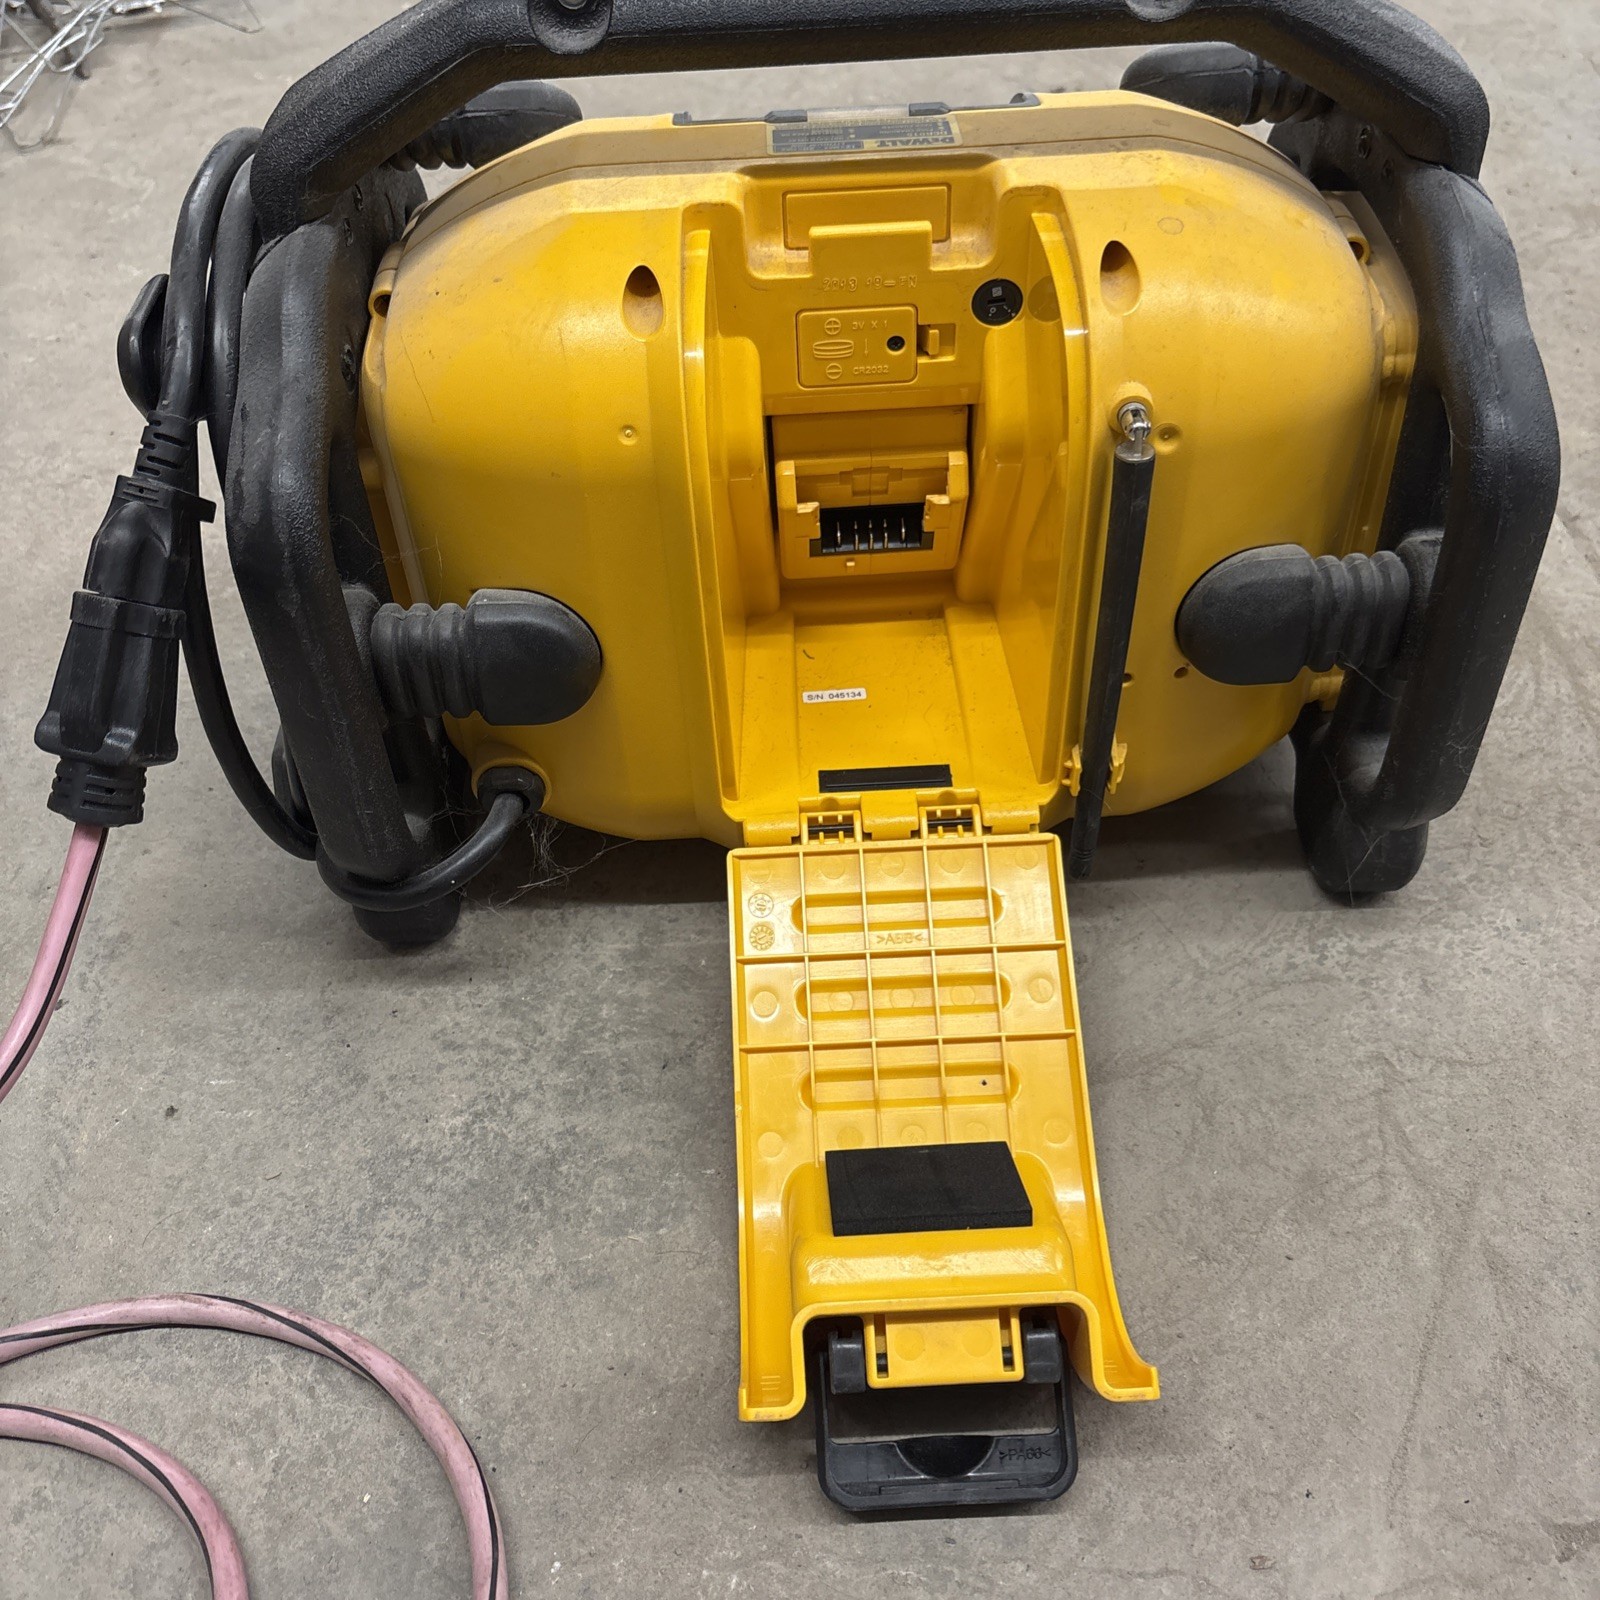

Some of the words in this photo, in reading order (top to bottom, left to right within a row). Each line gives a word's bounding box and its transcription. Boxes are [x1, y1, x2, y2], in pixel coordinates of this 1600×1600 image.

[852, 320, 865, 330] 3V
[852, 364, 889, 375] CR2032
[807, 693, 824, 701] S/N
[828, 691, 862, 700] 045134
